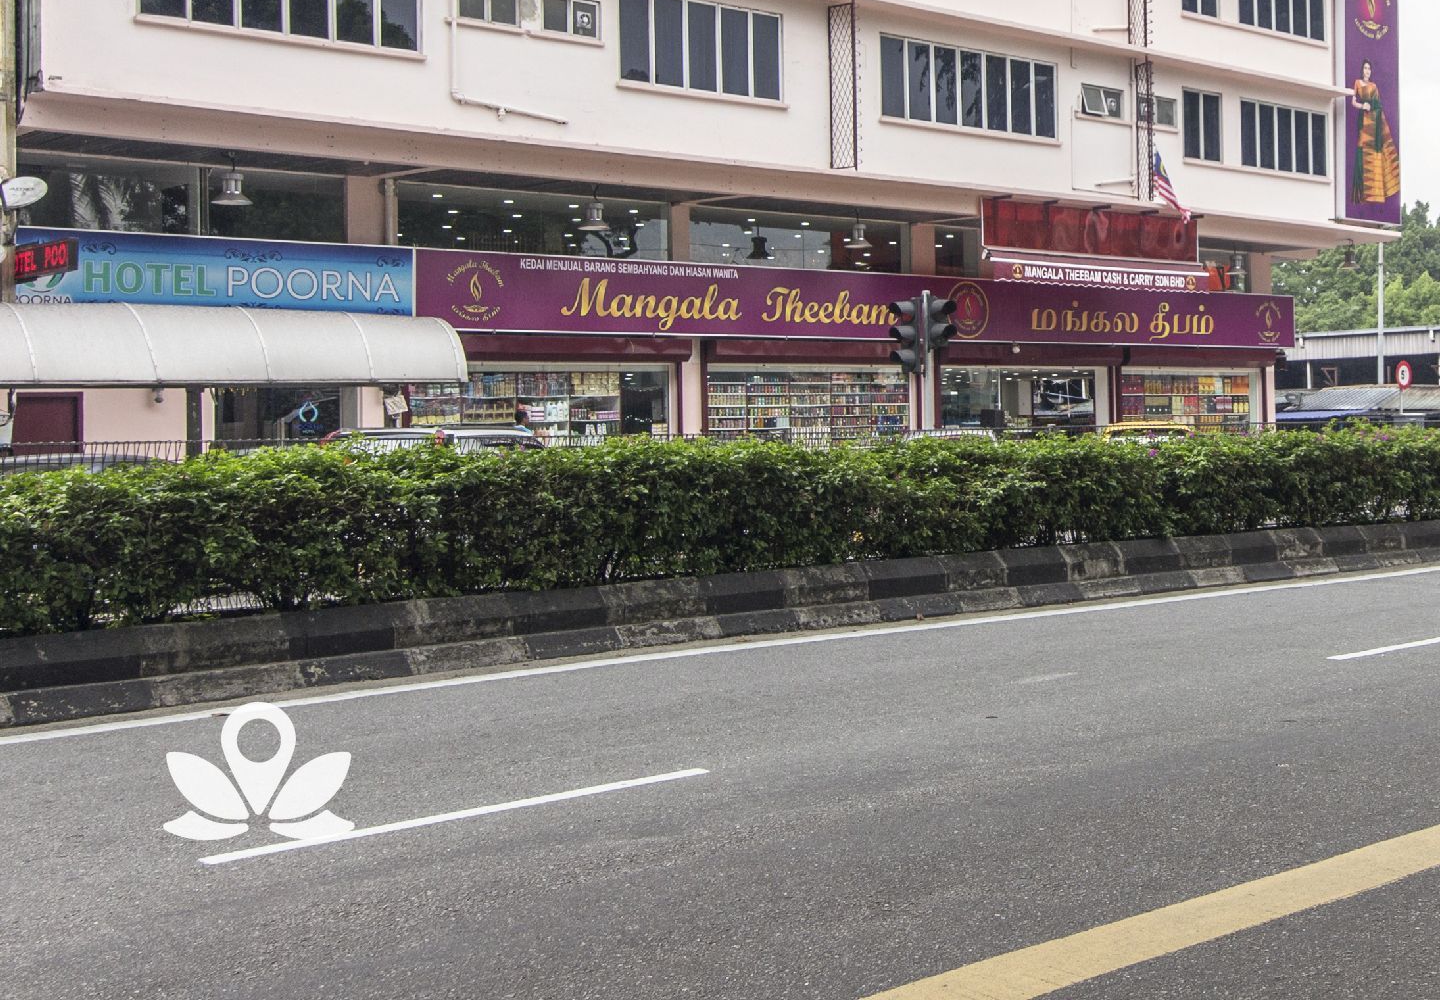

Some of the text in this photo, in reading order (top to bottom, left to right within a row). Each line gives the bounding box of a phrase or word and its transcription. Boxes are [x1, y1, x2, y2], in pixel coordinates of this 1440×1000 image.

[15, 250, 37, 273] TEL
[520, 258, 739, 279] KEDAI MENJUAL BARANG SEMBAHYANG DAN HIASAN WANITA
[83, 260, 401, 303] HOTEL POORNA
[1024, 265, 1185, 288] MANGALA THEEBAM CASH & CARRY SDN BHD
[15, 294, 72, 304] OORNA
[560, 277, 898, 330] Mangala Theebam
[1031, 300, 1139, 333] மங்கல
[1149, 302, 1215, 341] தீபம்
